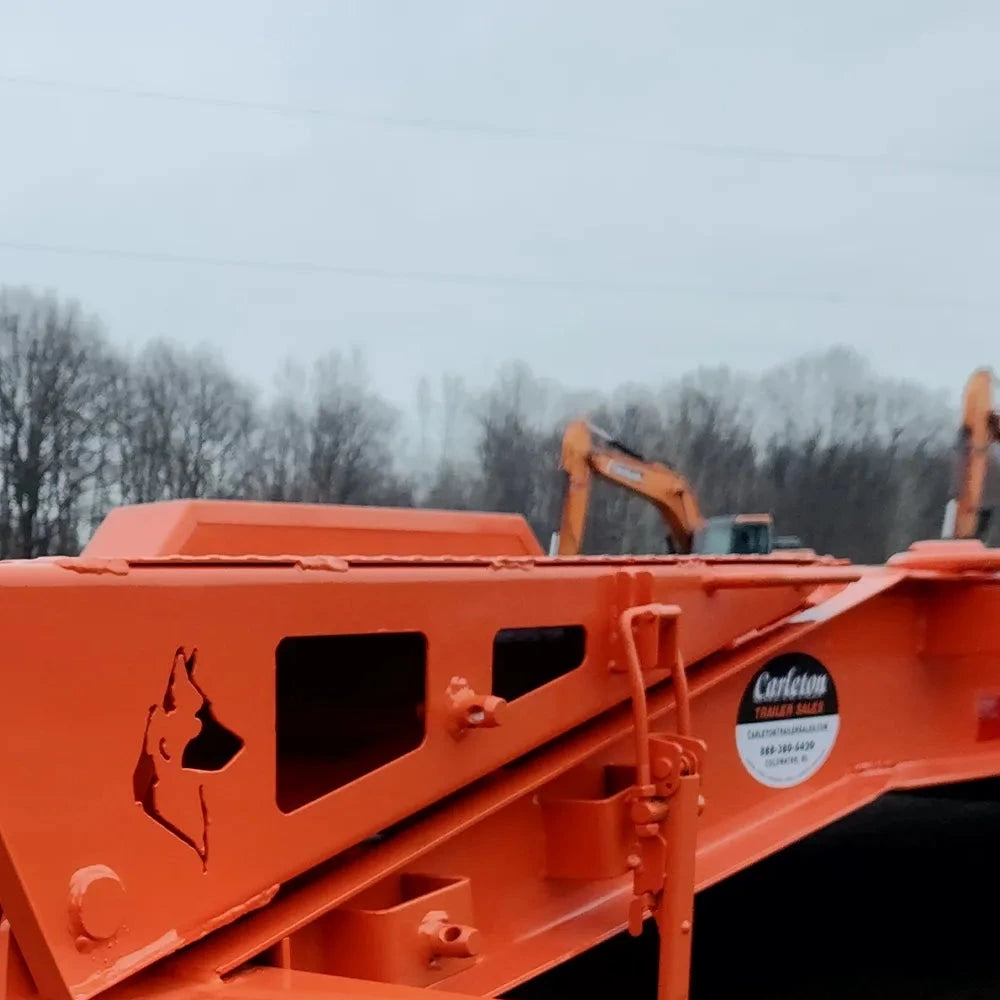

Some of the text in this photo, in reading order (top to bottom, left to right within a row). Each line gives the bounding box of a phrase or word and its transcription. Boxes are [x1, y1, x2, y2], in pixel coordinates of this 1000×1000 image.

[754, 666, 827, 701] Carleton
[755, 700, 824, 719] TRAILER SALES
